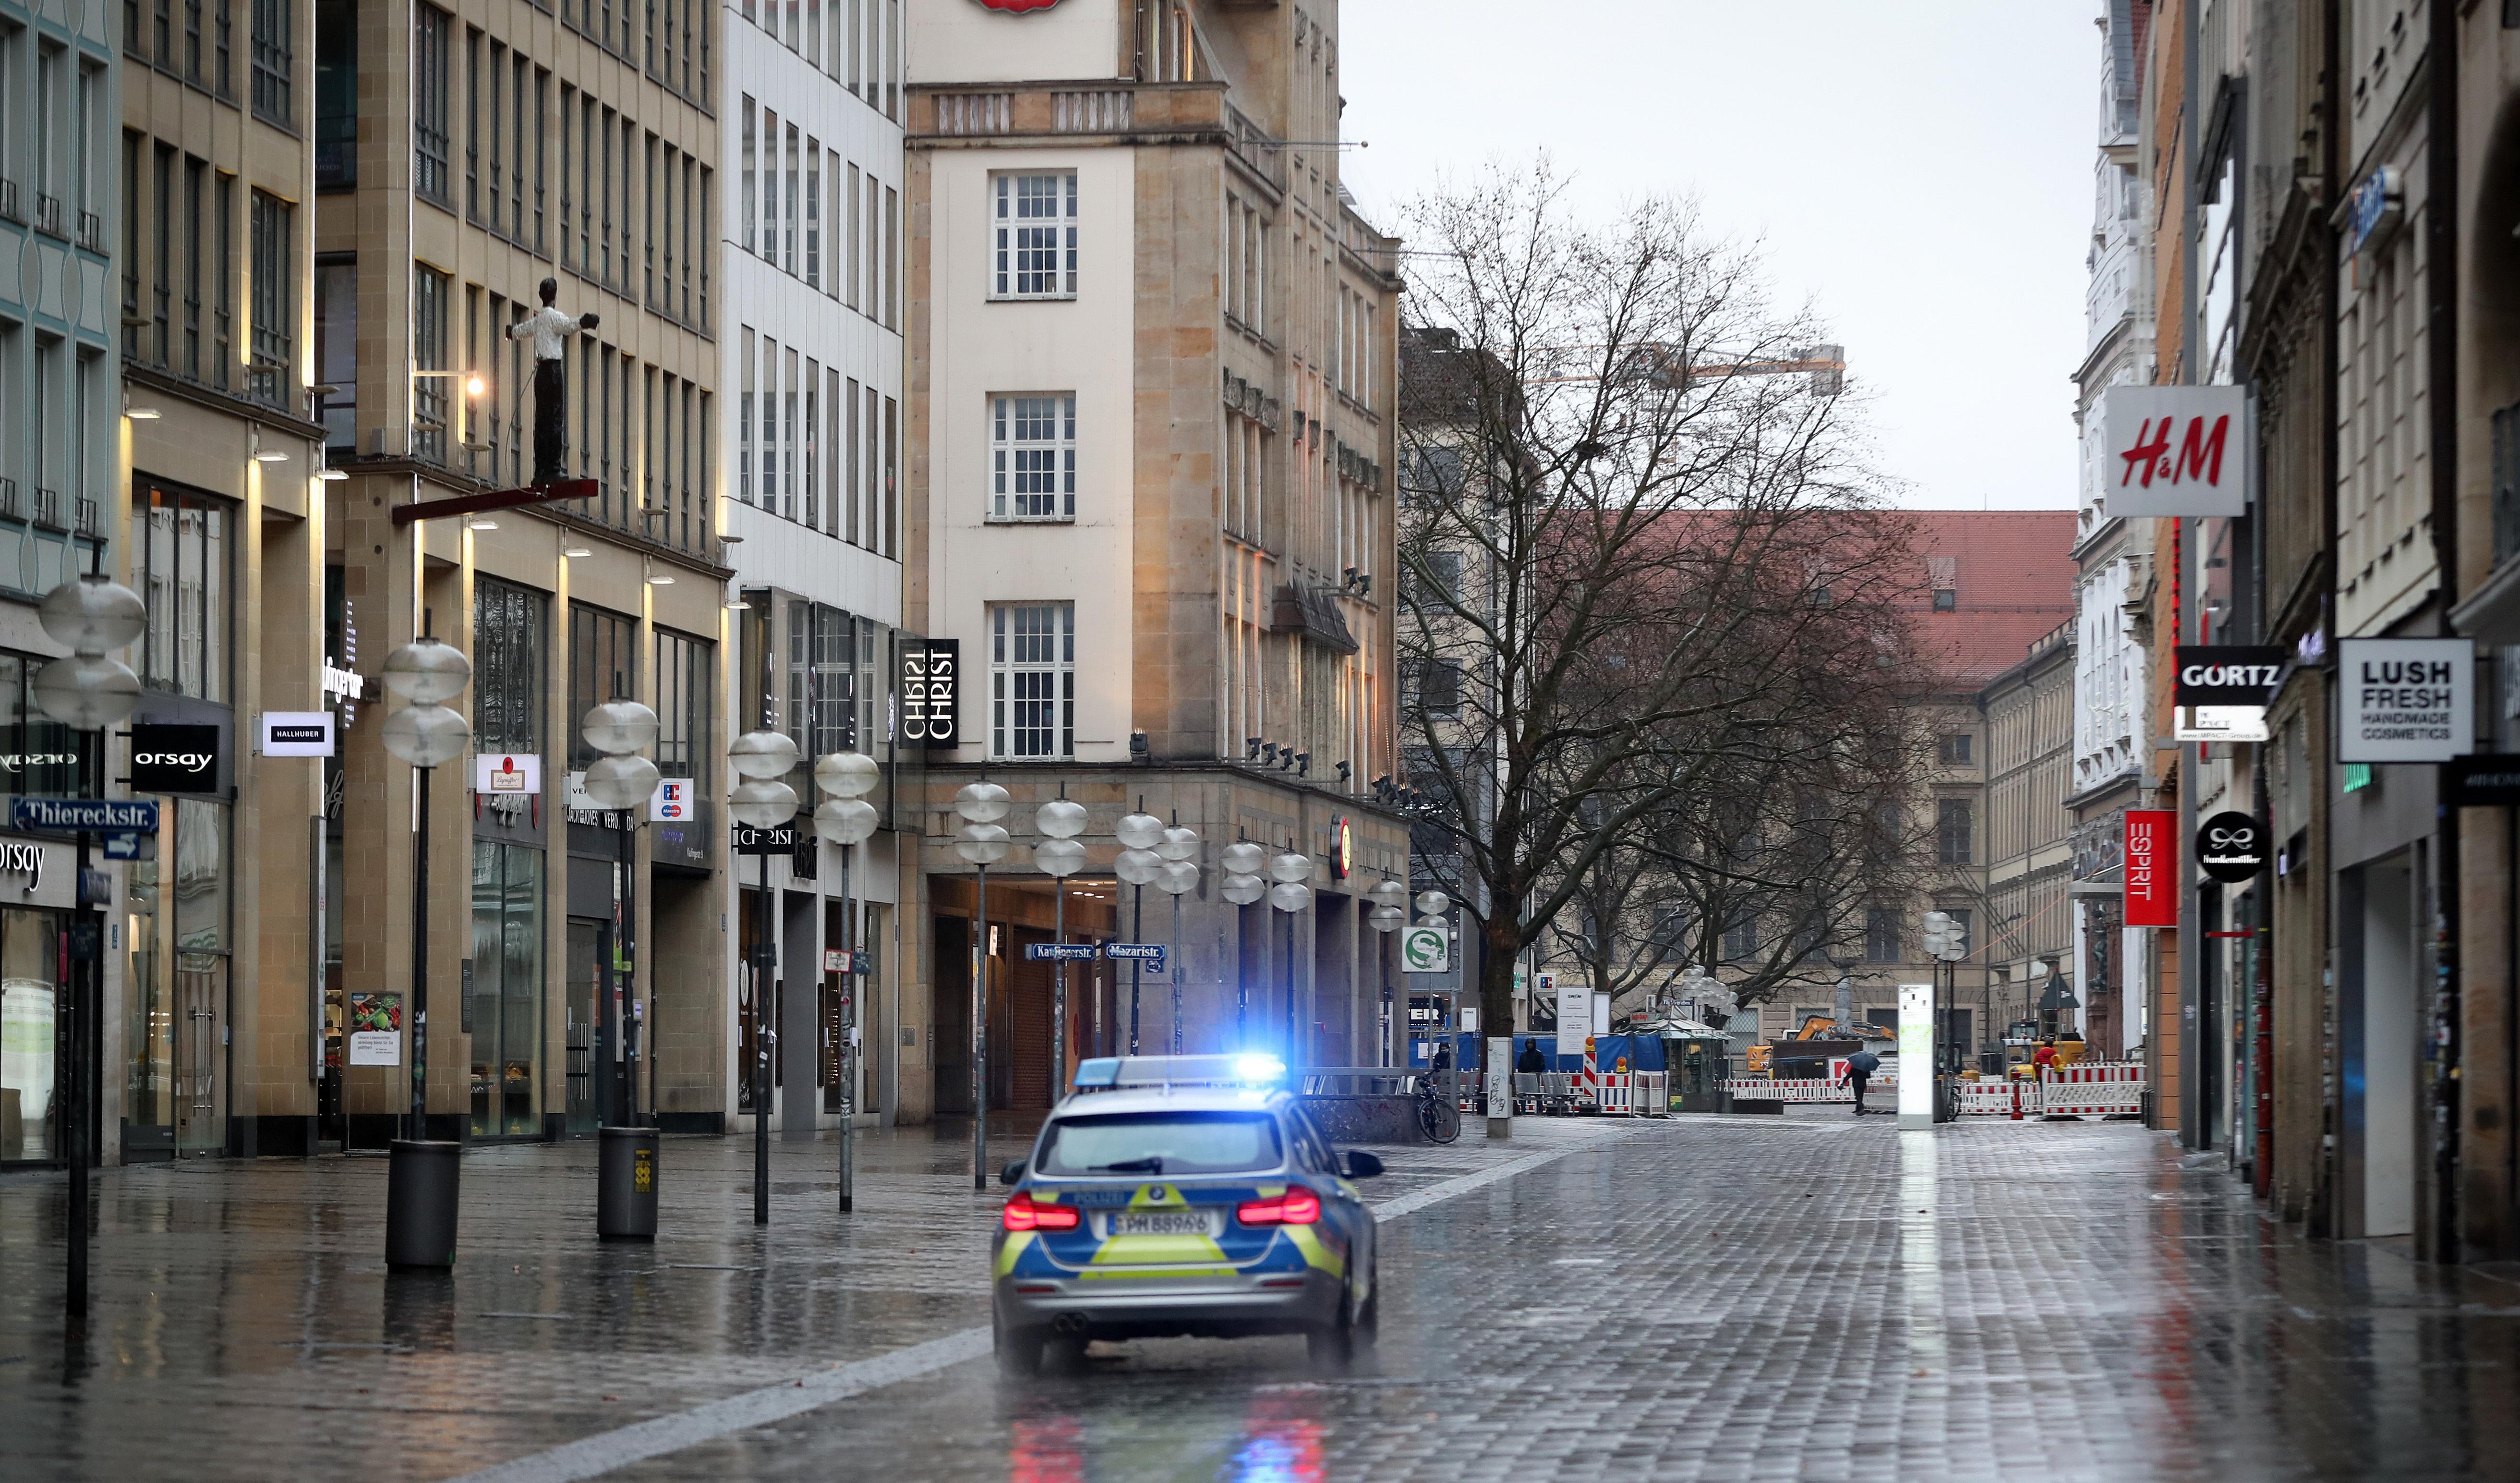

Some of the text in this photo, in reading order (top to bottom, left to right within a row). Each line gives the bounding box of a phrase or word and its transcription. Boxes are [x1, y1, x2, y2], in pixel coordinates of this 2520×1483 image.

[2120, 414, 2229, 488] H&M
[2362, 661, 2450, 684] LUSH
[929, 649, 953, 740] CHRIST
[2362, 688, 2451, 708] FRESH
[2361, 712, 2450, 724] HANDMADE
[2361, 728, 2451, 740] COSMETICS
[135, 753, 212, 772] orsay
[25, 800, 149, 827] Thiereckstr.
[604, 812, 618, 829] VERO
[2130, 823, 2152, 901] ESPRIT
